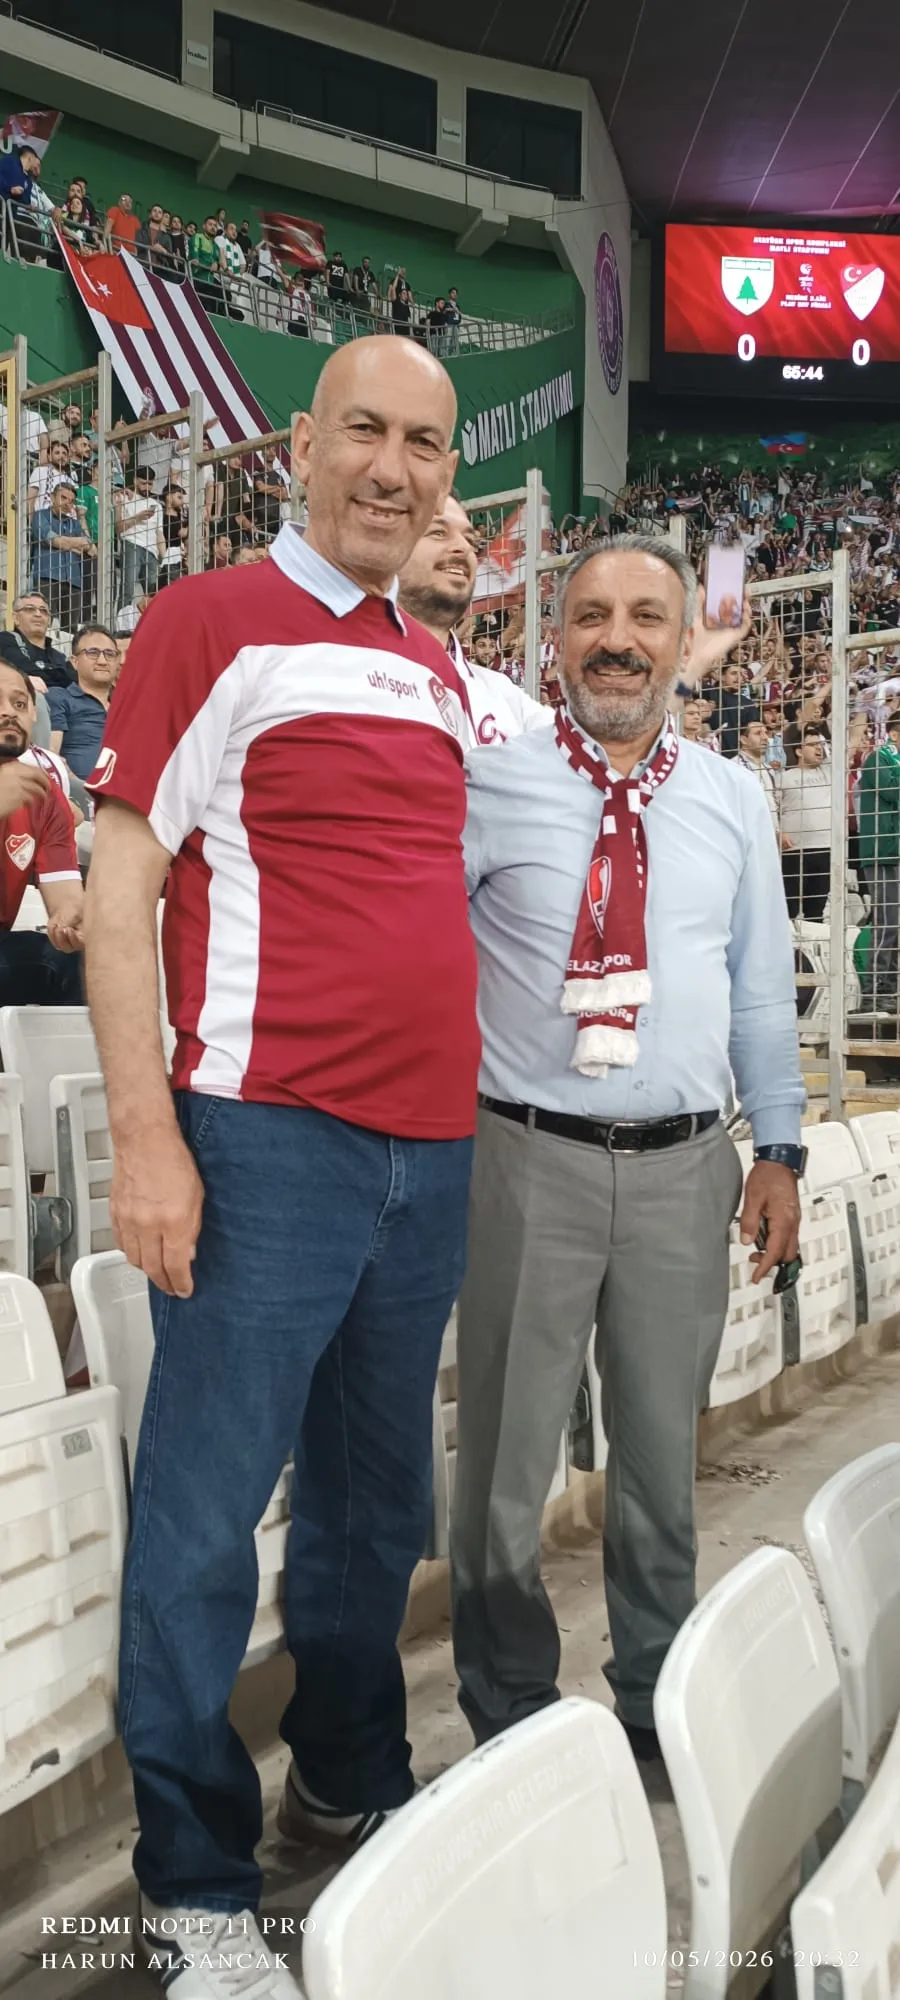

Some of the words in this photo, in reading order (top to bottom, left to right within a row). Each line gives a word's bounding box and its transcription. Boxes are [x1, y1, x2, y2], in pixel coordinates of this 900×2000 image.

[331, 264, 345, 277] 23
[738, 334, 756, 361] 0
[852, 339, 871, 366] 0
[782, 365, 825, 381] 65:44
[477, 401, 516, 462] MATLI
[519, 369, 574, 441] STADYUMU
[367, 670, 421, 701] uhlsport
